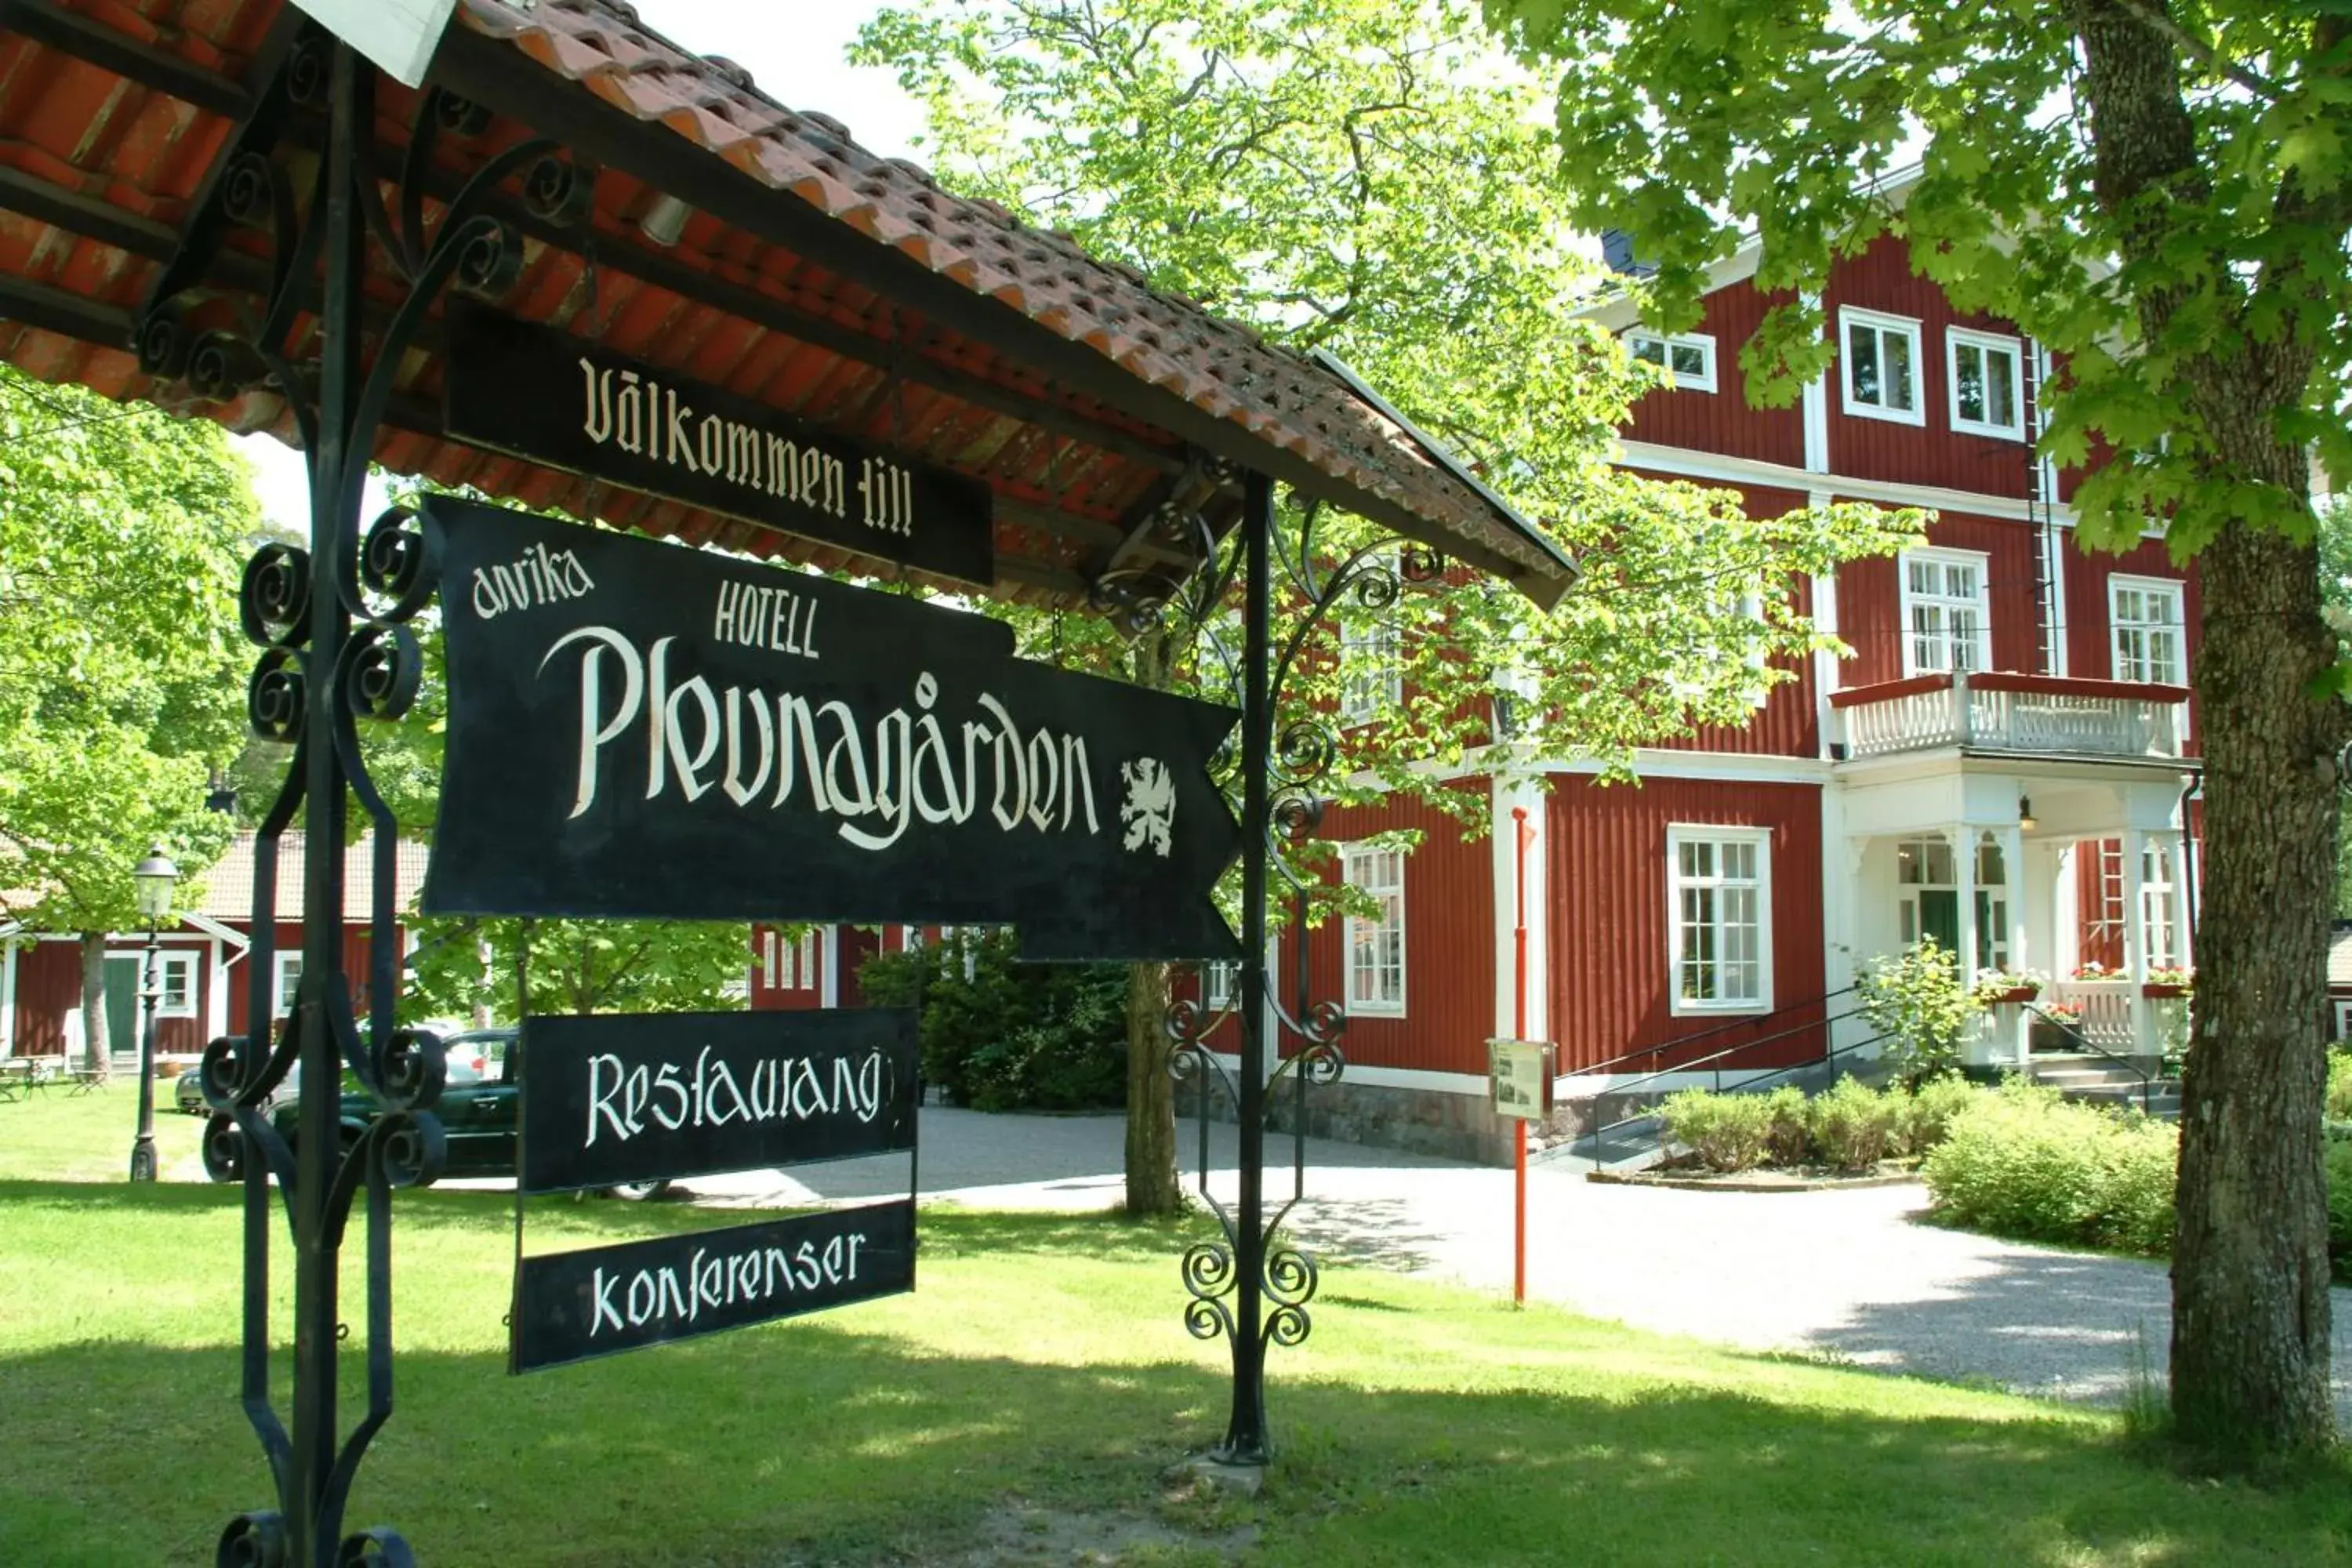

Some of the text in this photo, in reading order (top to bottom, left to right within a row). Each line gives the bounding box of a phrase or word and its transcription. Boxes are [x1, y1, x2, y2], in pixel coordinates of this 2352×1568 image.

[579, 357, 912, 537] Välkommen till
[714, 579, 818, 659] HOTELL
[537, 626, 1099, 851] Plevnagården
[585, 1045, 880, 1148] Restaurang
